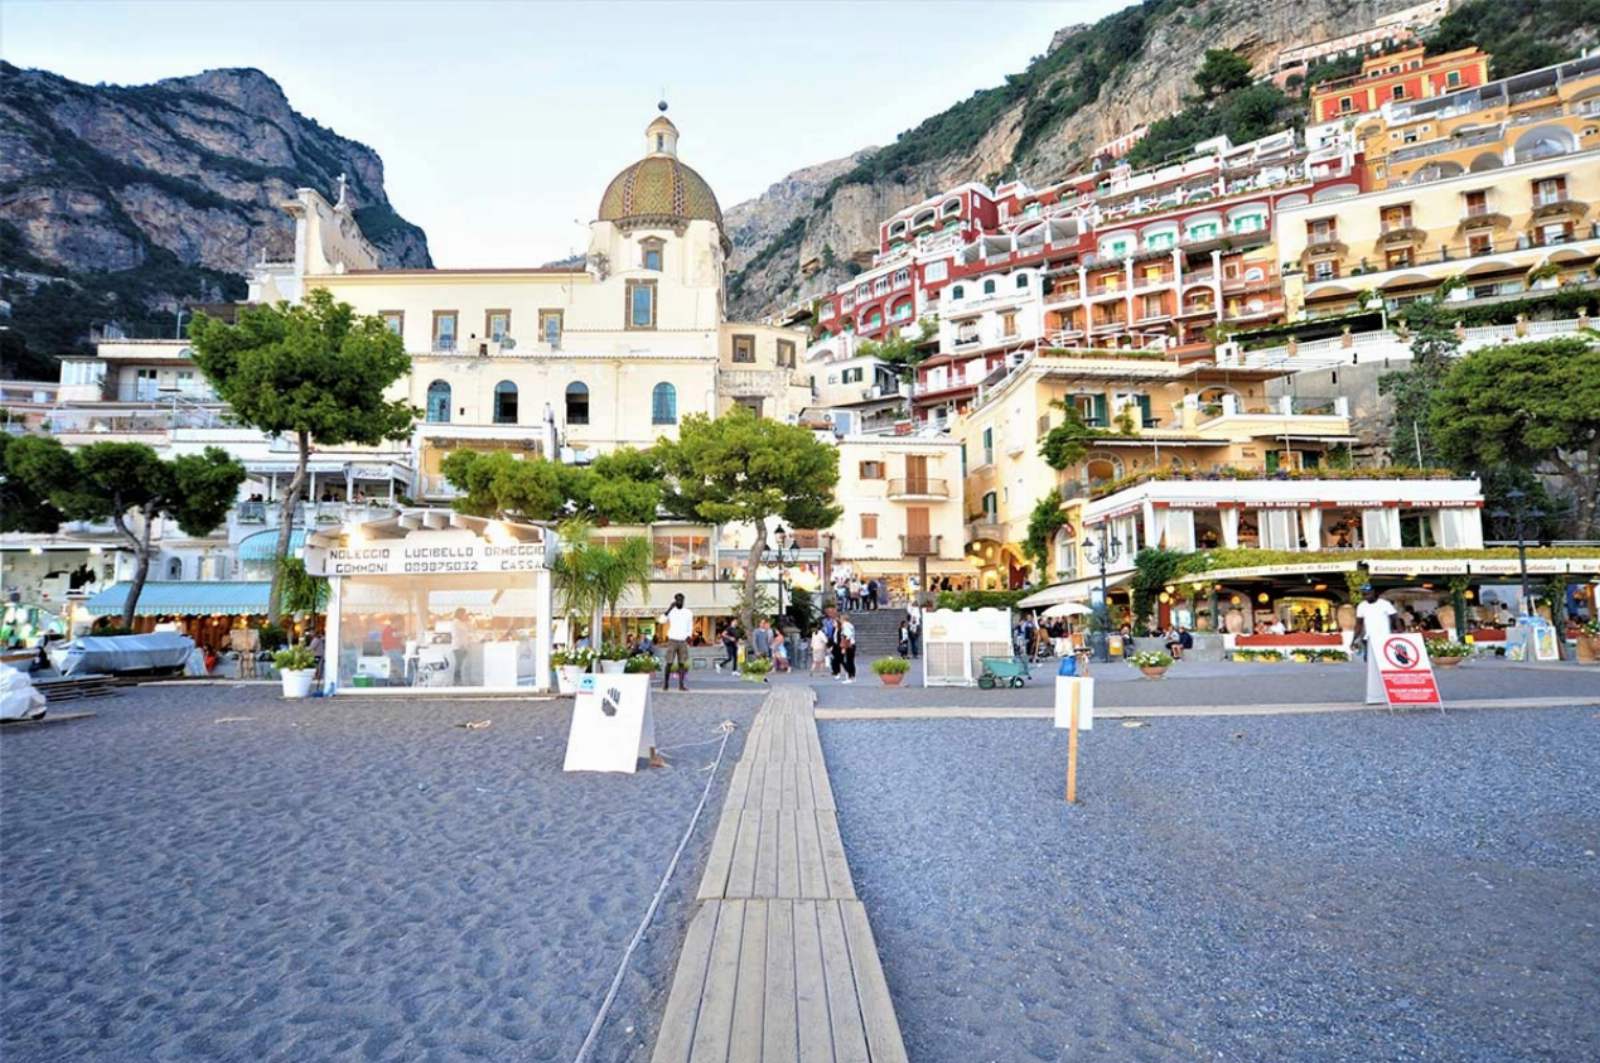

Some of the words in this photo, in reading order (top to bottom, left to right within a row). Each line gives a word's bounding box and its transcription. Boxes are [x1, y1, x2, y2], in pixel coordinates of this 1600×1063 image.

[330, 549, 390, 560] NOLEGGIO
[404, 546, 474, 558] LUCIBELLO
[484, 545, 546, 557] ORMEGGIO
